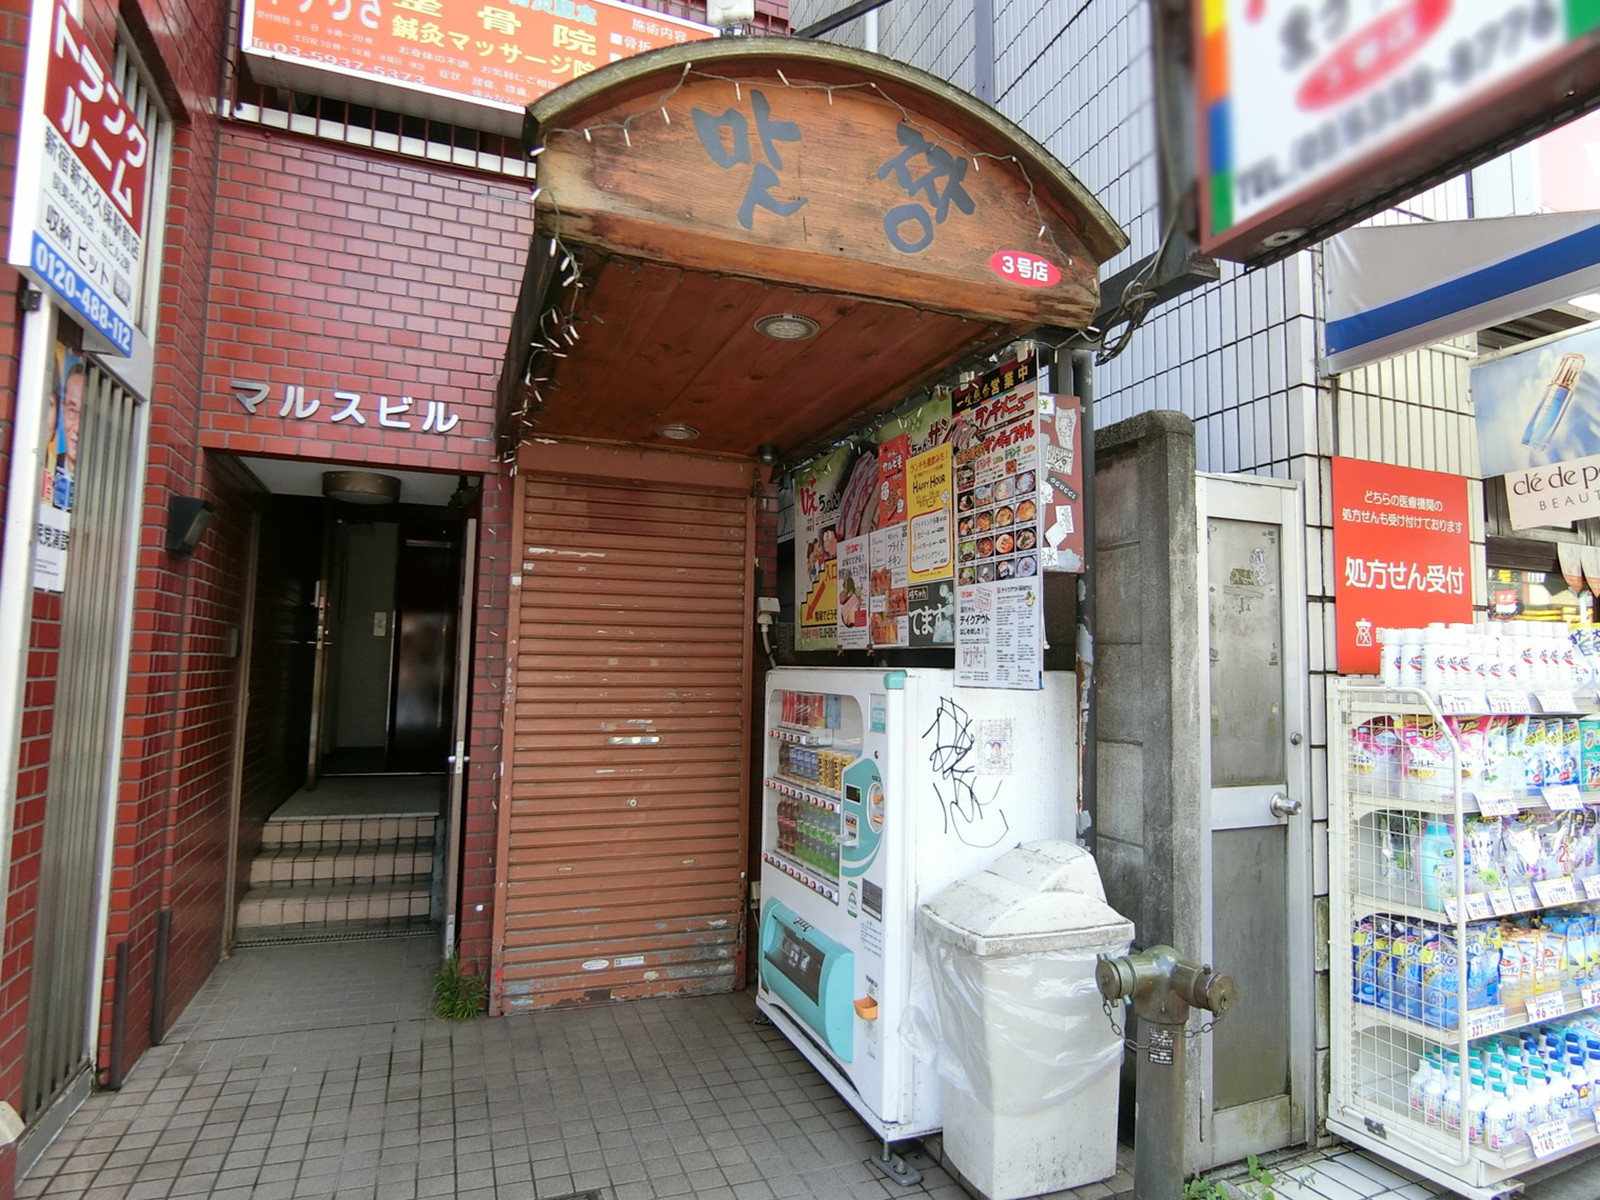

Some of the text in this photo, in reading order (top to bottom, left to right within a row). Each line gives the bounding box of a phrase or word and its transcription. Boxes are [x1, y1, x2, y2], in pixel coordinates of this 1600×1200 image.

[632, 18, 687, 43] 施術内容
[55, 4, 148, 168] トランク
[61, 86, 133, 218] ルーム
[1002, 255, 1048, 282] 3号店
[36, 242, 131, 350] 0120-488-112
[231, 381, 459, 432] マルスビル
[975, 392, 1034, 427] ランチメニュー
[912, 475, 946, 495] HAPPY HOUR
[1513, 466, 1600, 495] clé de p
[1364, 490, 1443, 512] どちらの医療機関の
[1342, 508, 1463, 534] 処方せんも受け付けております
[1345, 556, 1464, 595] 処方せん受付
[960, 614, 991, 625] テイクアウト
